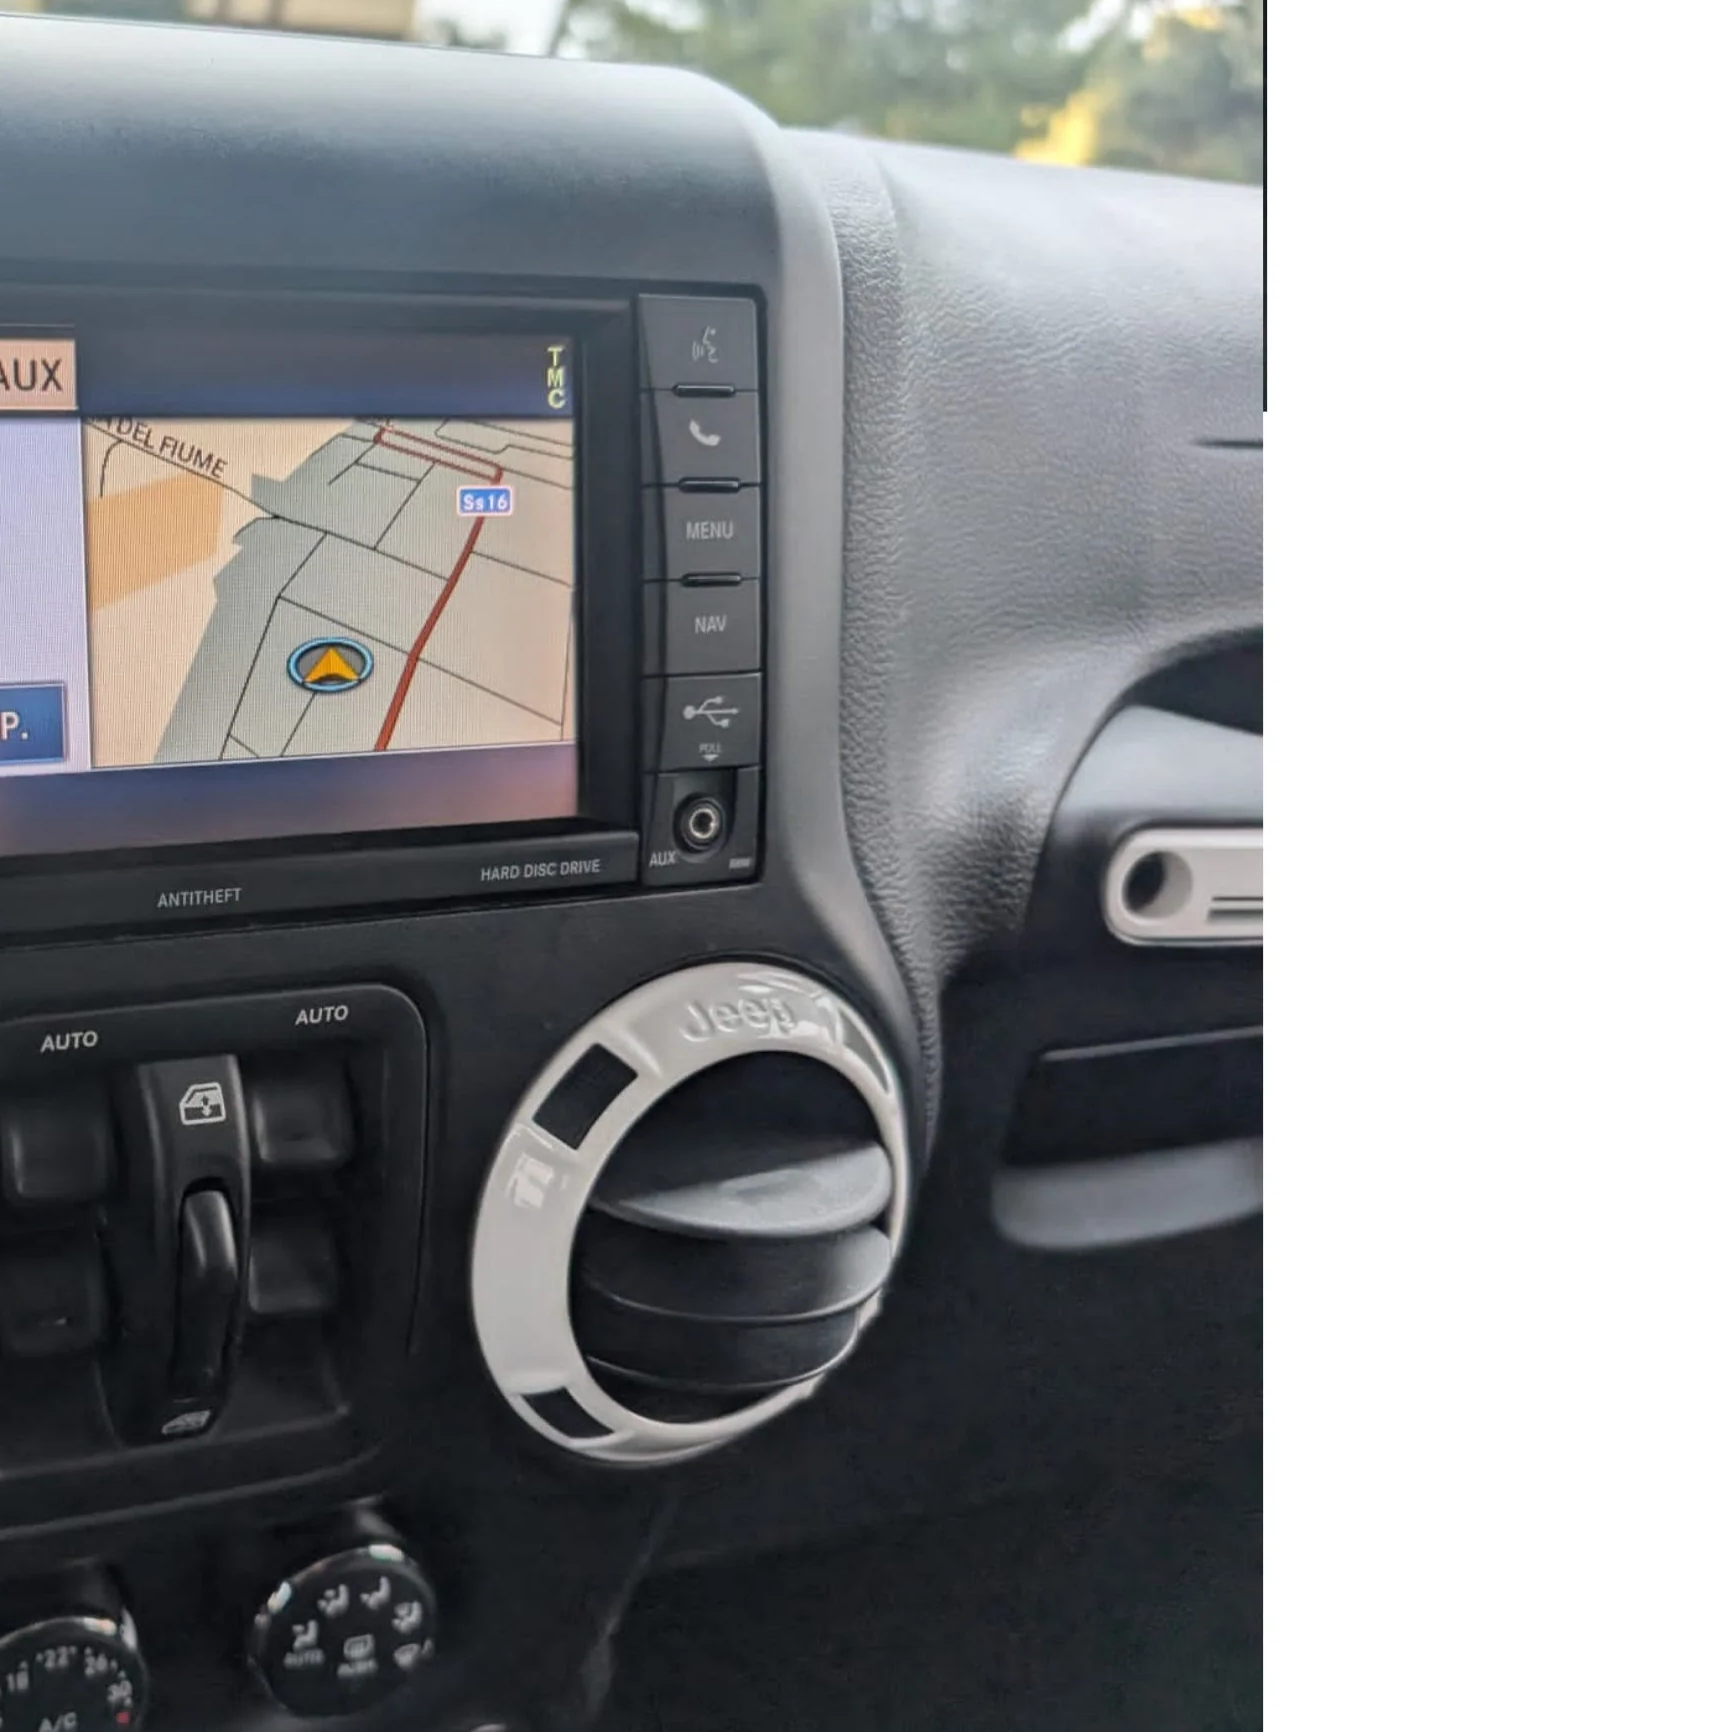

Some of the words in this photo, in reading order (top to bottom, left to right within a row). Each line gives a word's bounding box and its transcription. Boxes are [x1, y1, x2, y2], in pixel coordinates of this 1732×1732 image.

[117, 417, 155, 449] DEL
[159, 435, 229, 479] FIUME
[684, 519, 734, 540] MENU
[694, 615, 727, 634] NAV
[480, 864, 520, 883] HARD
[523, 861, 561, 880] DISC
[564, 858, 601, 876] DRIVE
[648, 850, 677, 868] AUX
[157, 886, 242, 909] ANTITHEFT
[294, 1004, 350, 1026] AUTO
[678, 998, 797, 1042] Jeep
[39, 1030, 99, 1053] AUTO
